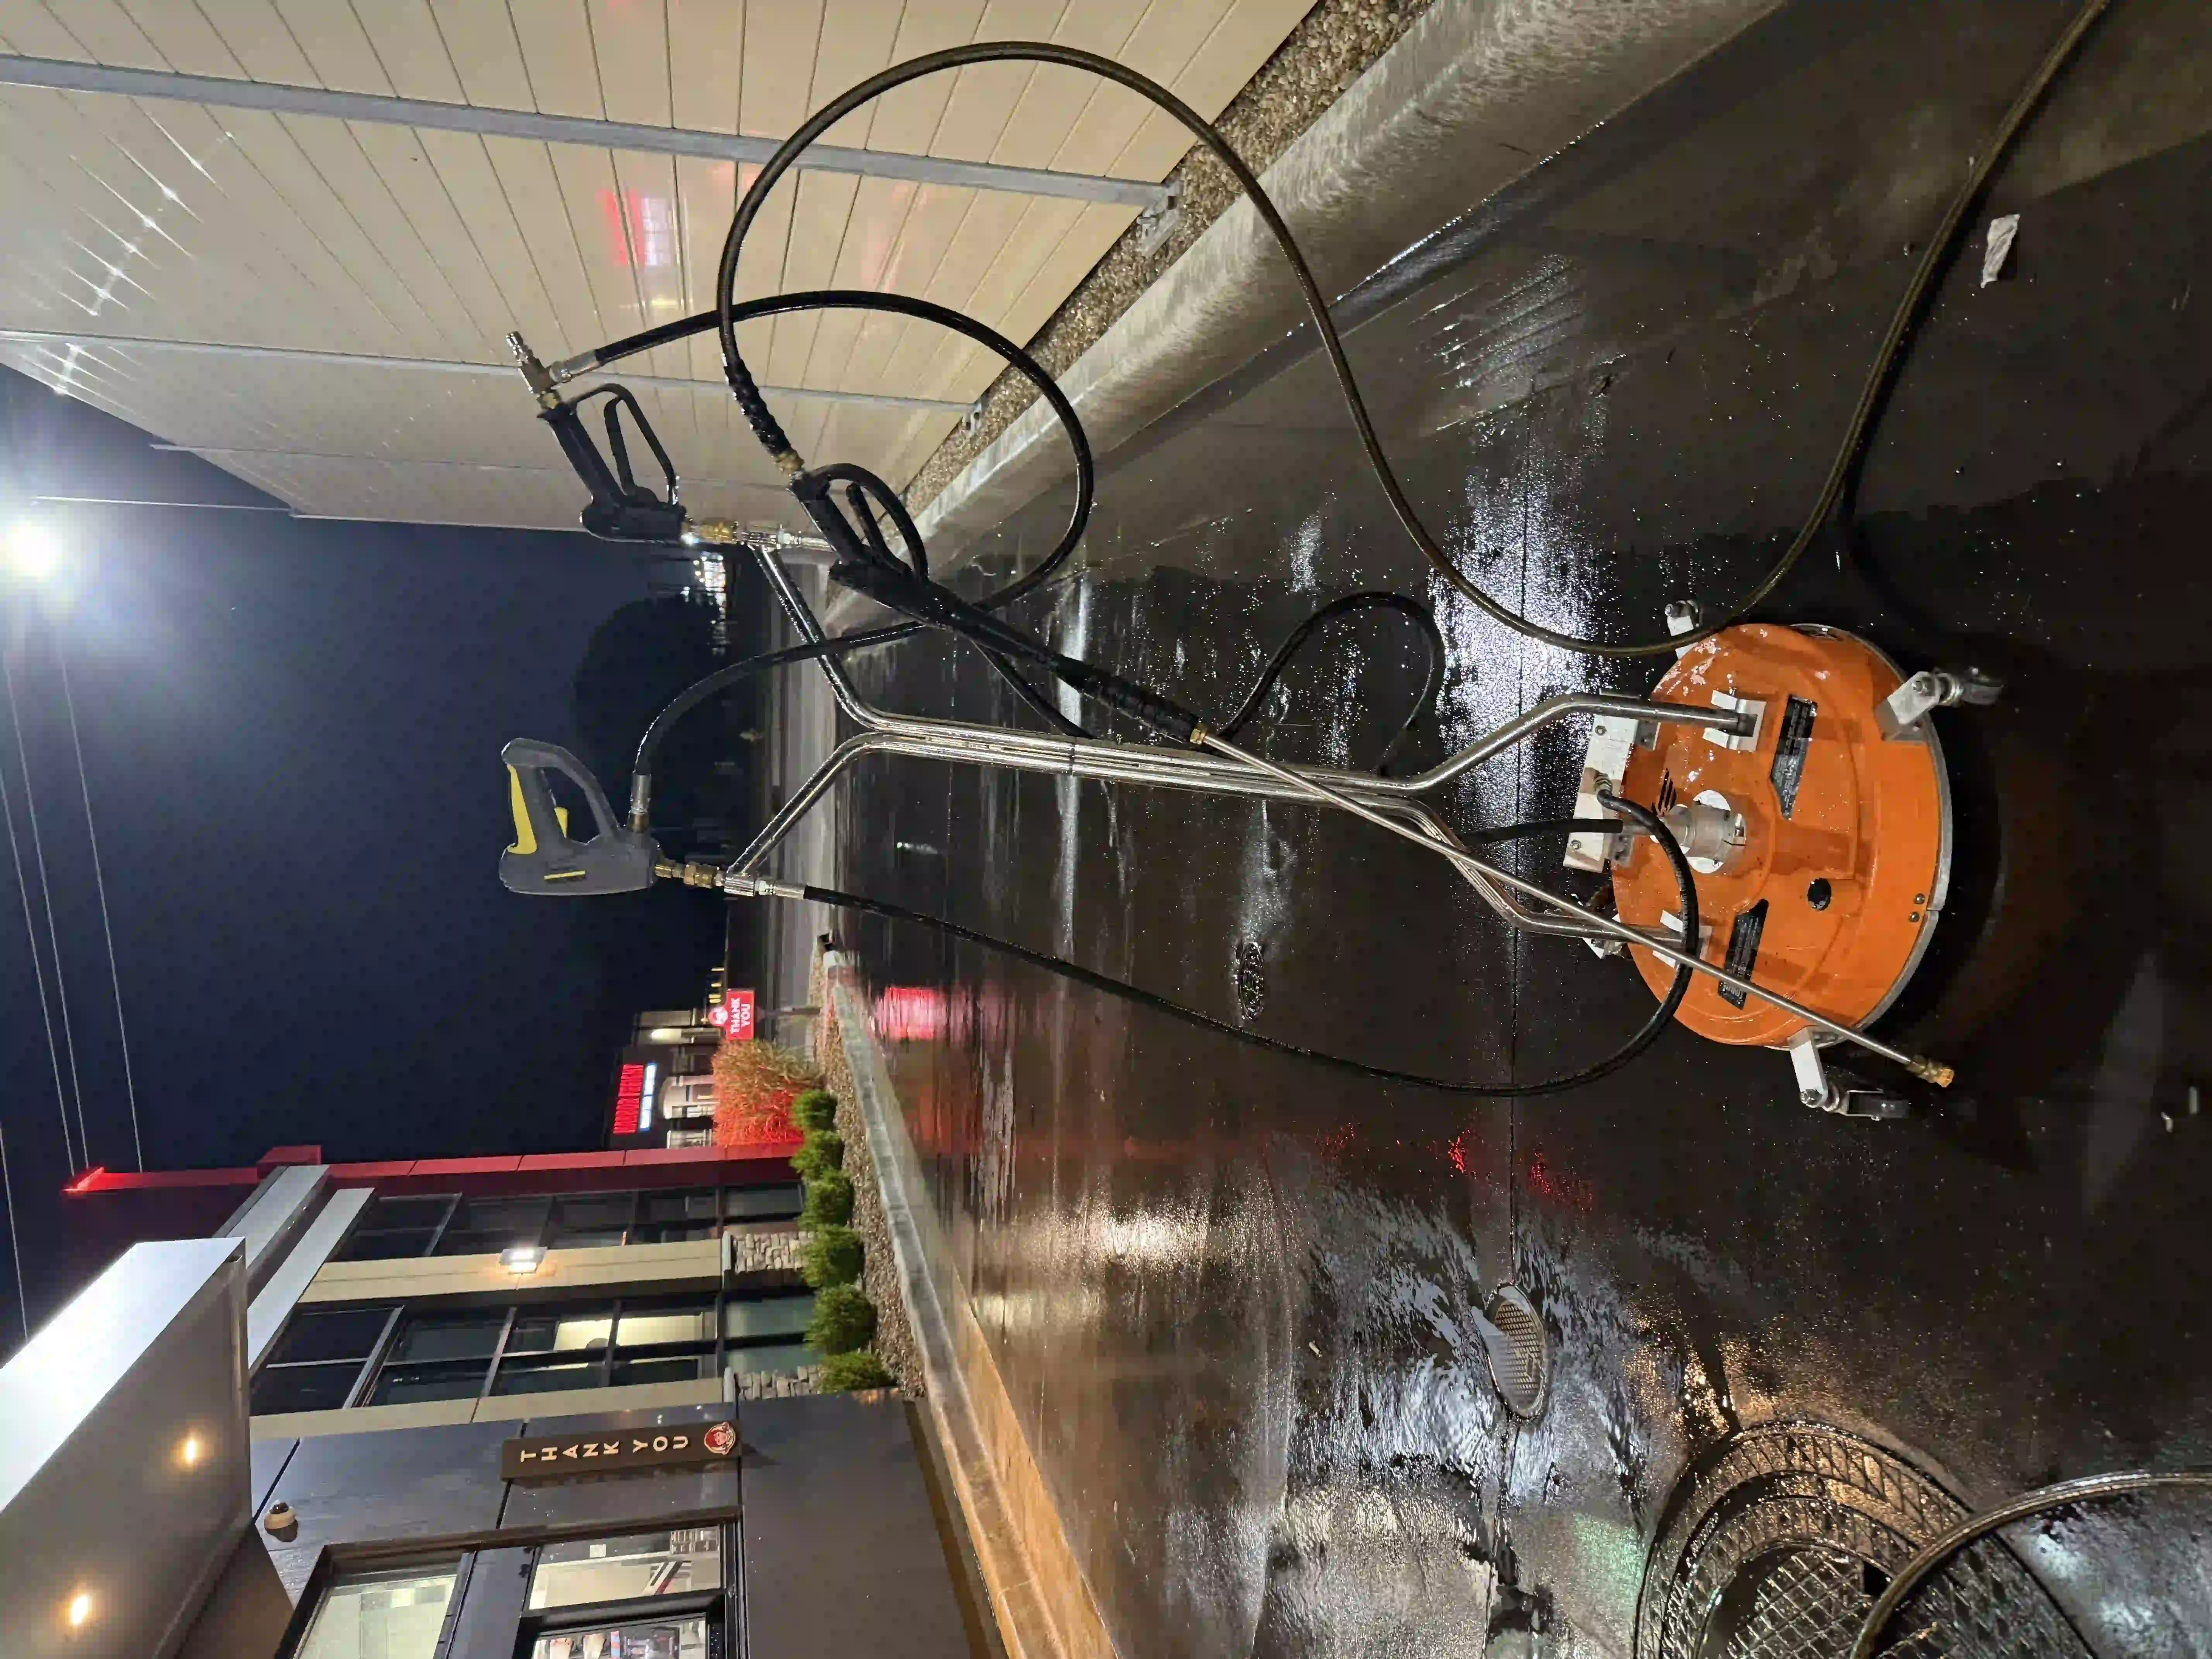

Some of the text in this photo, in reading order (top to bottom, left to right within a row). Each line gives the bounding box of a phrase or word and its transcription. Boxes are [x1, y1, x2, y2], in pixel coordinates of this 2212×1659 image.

[730, 998, 740, 1034] THANK
[740, 1003, 750, 1027] YOU
[520, 1436, 689, 1463] THANK YOU
